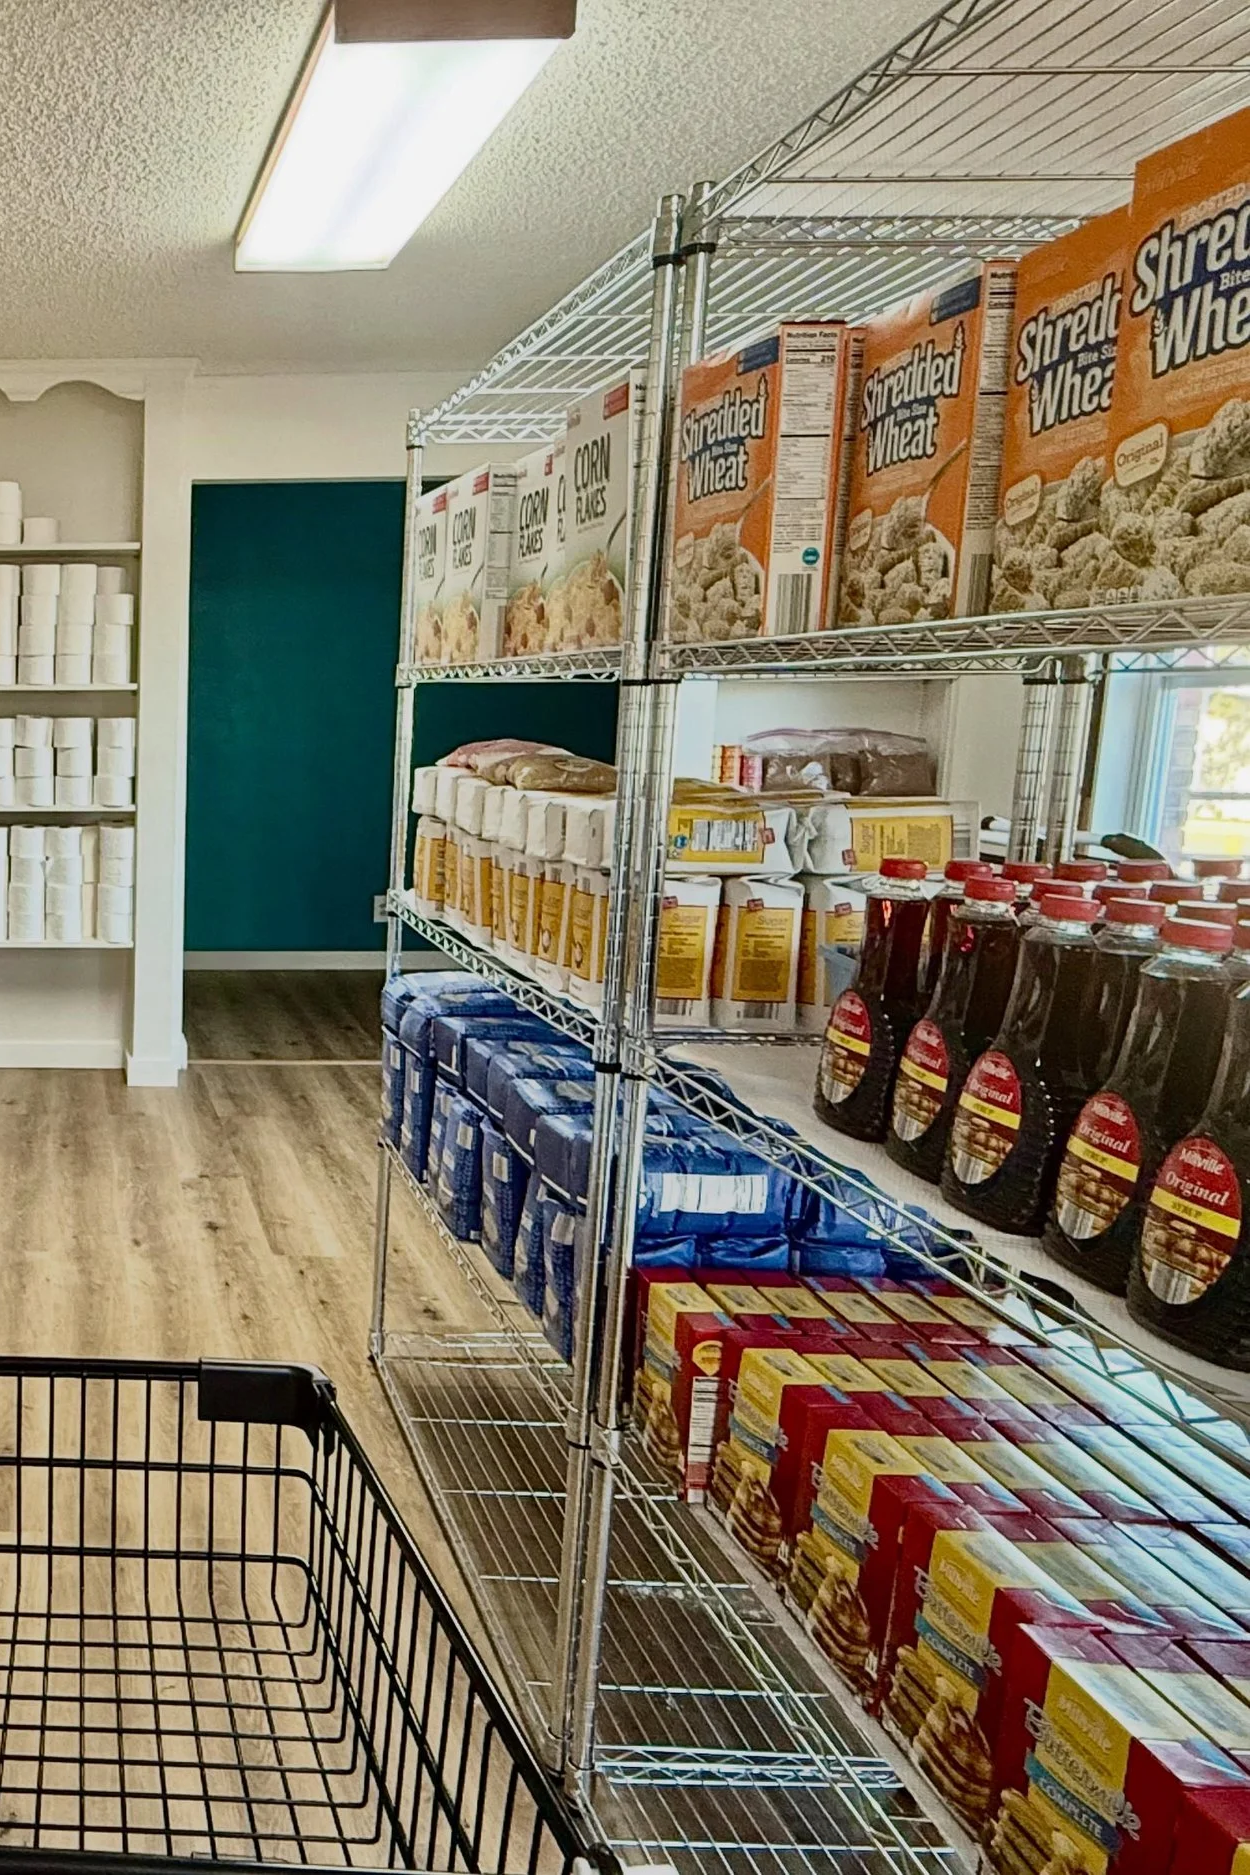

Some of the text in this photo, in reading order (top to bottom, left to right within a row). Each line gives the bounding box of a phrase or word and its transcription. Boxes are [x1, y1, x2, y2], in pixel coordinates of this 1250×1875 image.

[1180, 182, 1247, 231] FROSTED
[860, 321, 965, 431] Shredded
[1077, 352, 1099, 368] Bite
[681, 374, 767, 463] Shredded
[574, 432, 610, 492] CORN
[866, 405, 939, 477] Wheat
[1116, 432, 1164, 468] Original
[687, 443, 748, 503] Wheat
[453, 506, 476, 546] CORN
[519, 486, 549, 531] CORN
[576, 485, 606, 525] FLAKES
[453, 542, 472, 569] FLAKES
[518, 528, 543, 557] FLAKES
[860, 823, 870, 854] Sugar
[672, 912, 701, 924] Sugar
[757, 915, 788, 927] Sugar
[1079, 1122, 1131, 1153] Original
[1179, 1148, 1225, 1175] Millville
[1165, 1171, 1230, 1206] Original
[914, 1565, 1002, 1676] Buttermilk
[924, 1632, 975, 1678] COMPLETE
[1057, 1695, 1111, 1753] Millville
[1023, 1697, 1141, 1841] Buttermilk
[1038, 1776, 1103, 1839] COMPLETE
